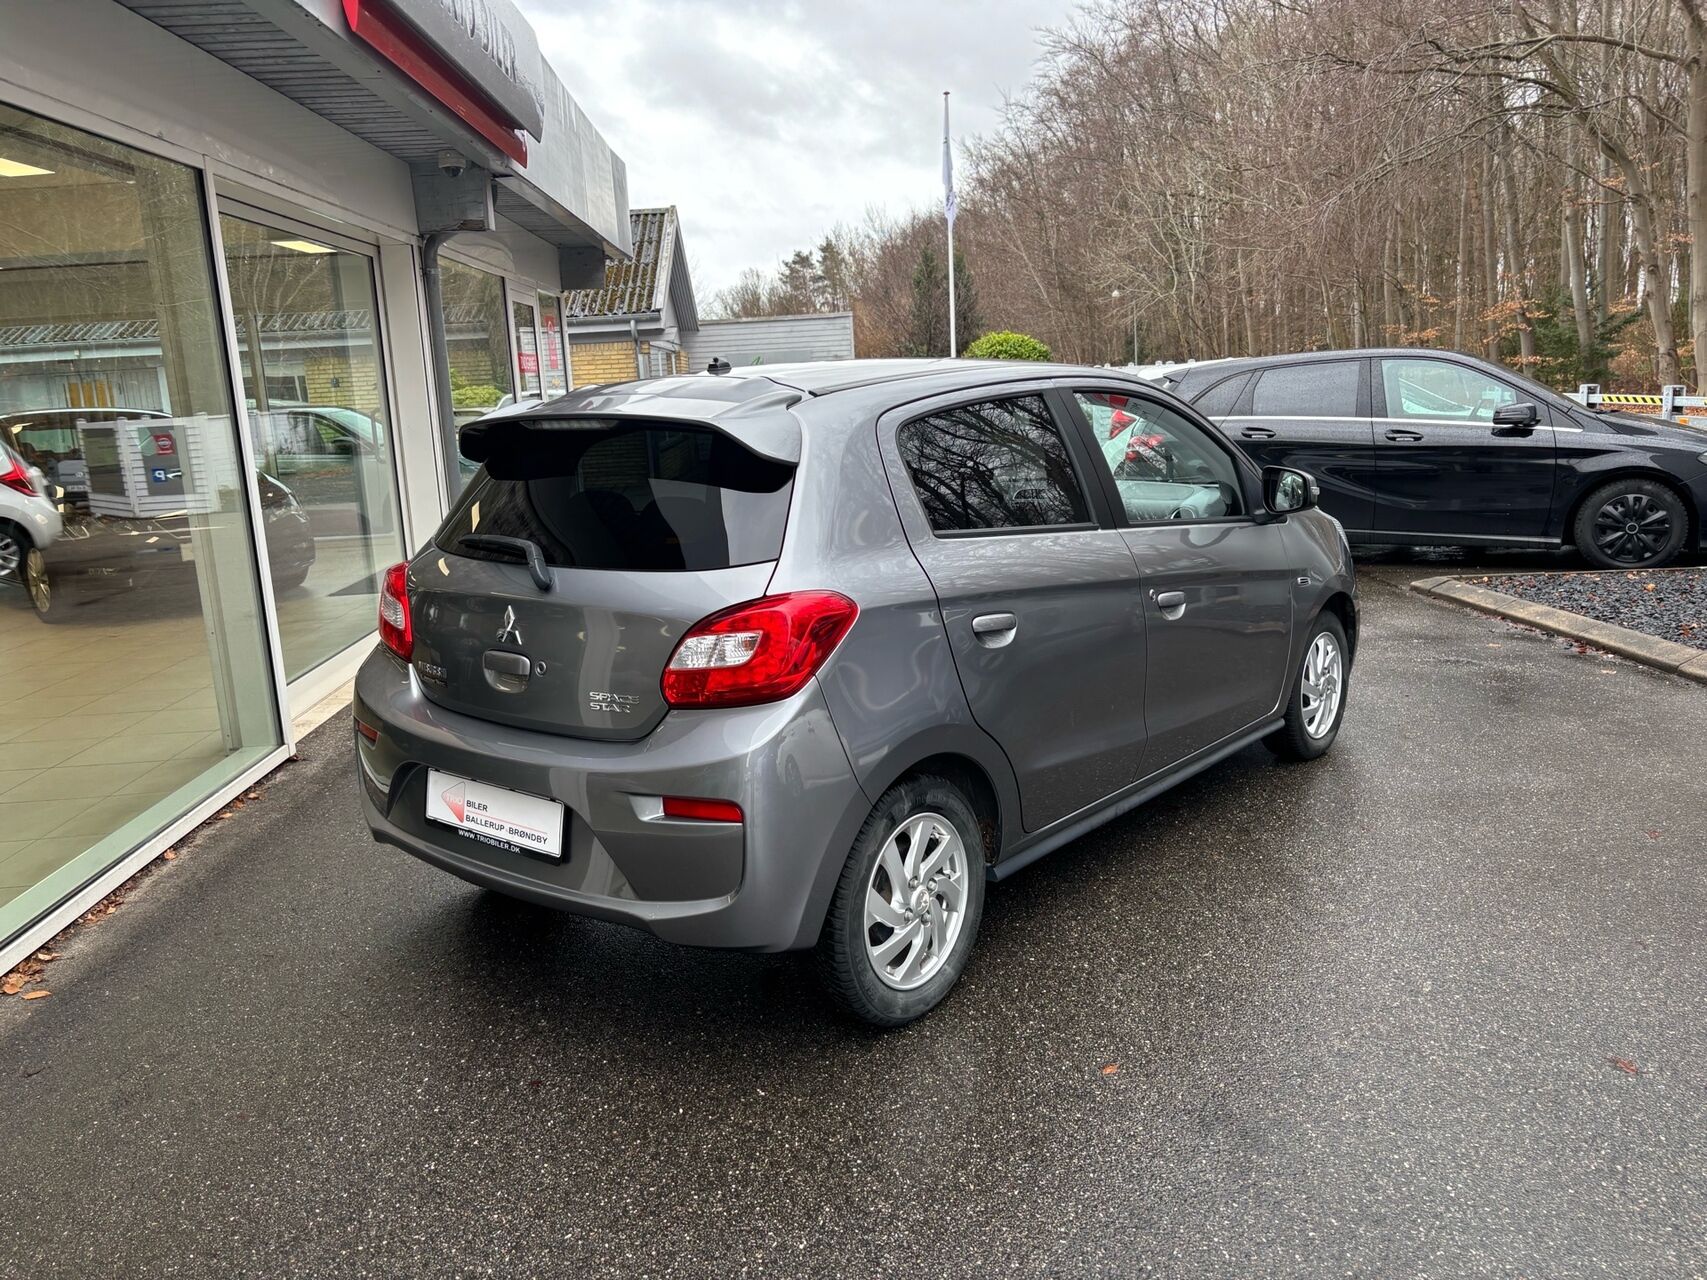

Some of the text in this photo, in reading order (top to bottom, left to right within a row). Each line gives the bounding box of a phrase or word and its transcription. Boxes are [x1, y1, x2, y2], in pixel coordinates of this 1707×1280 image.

[589, 691, 640, 704] SPACE
[589, 702, 631, 713] STAR
[466, 799, 488, 812] BILER
[465, 814, 548, 845] BALLERUP BRØNDBY
[458, 828, 521, 854] WWW.TRIOBILER.DK
